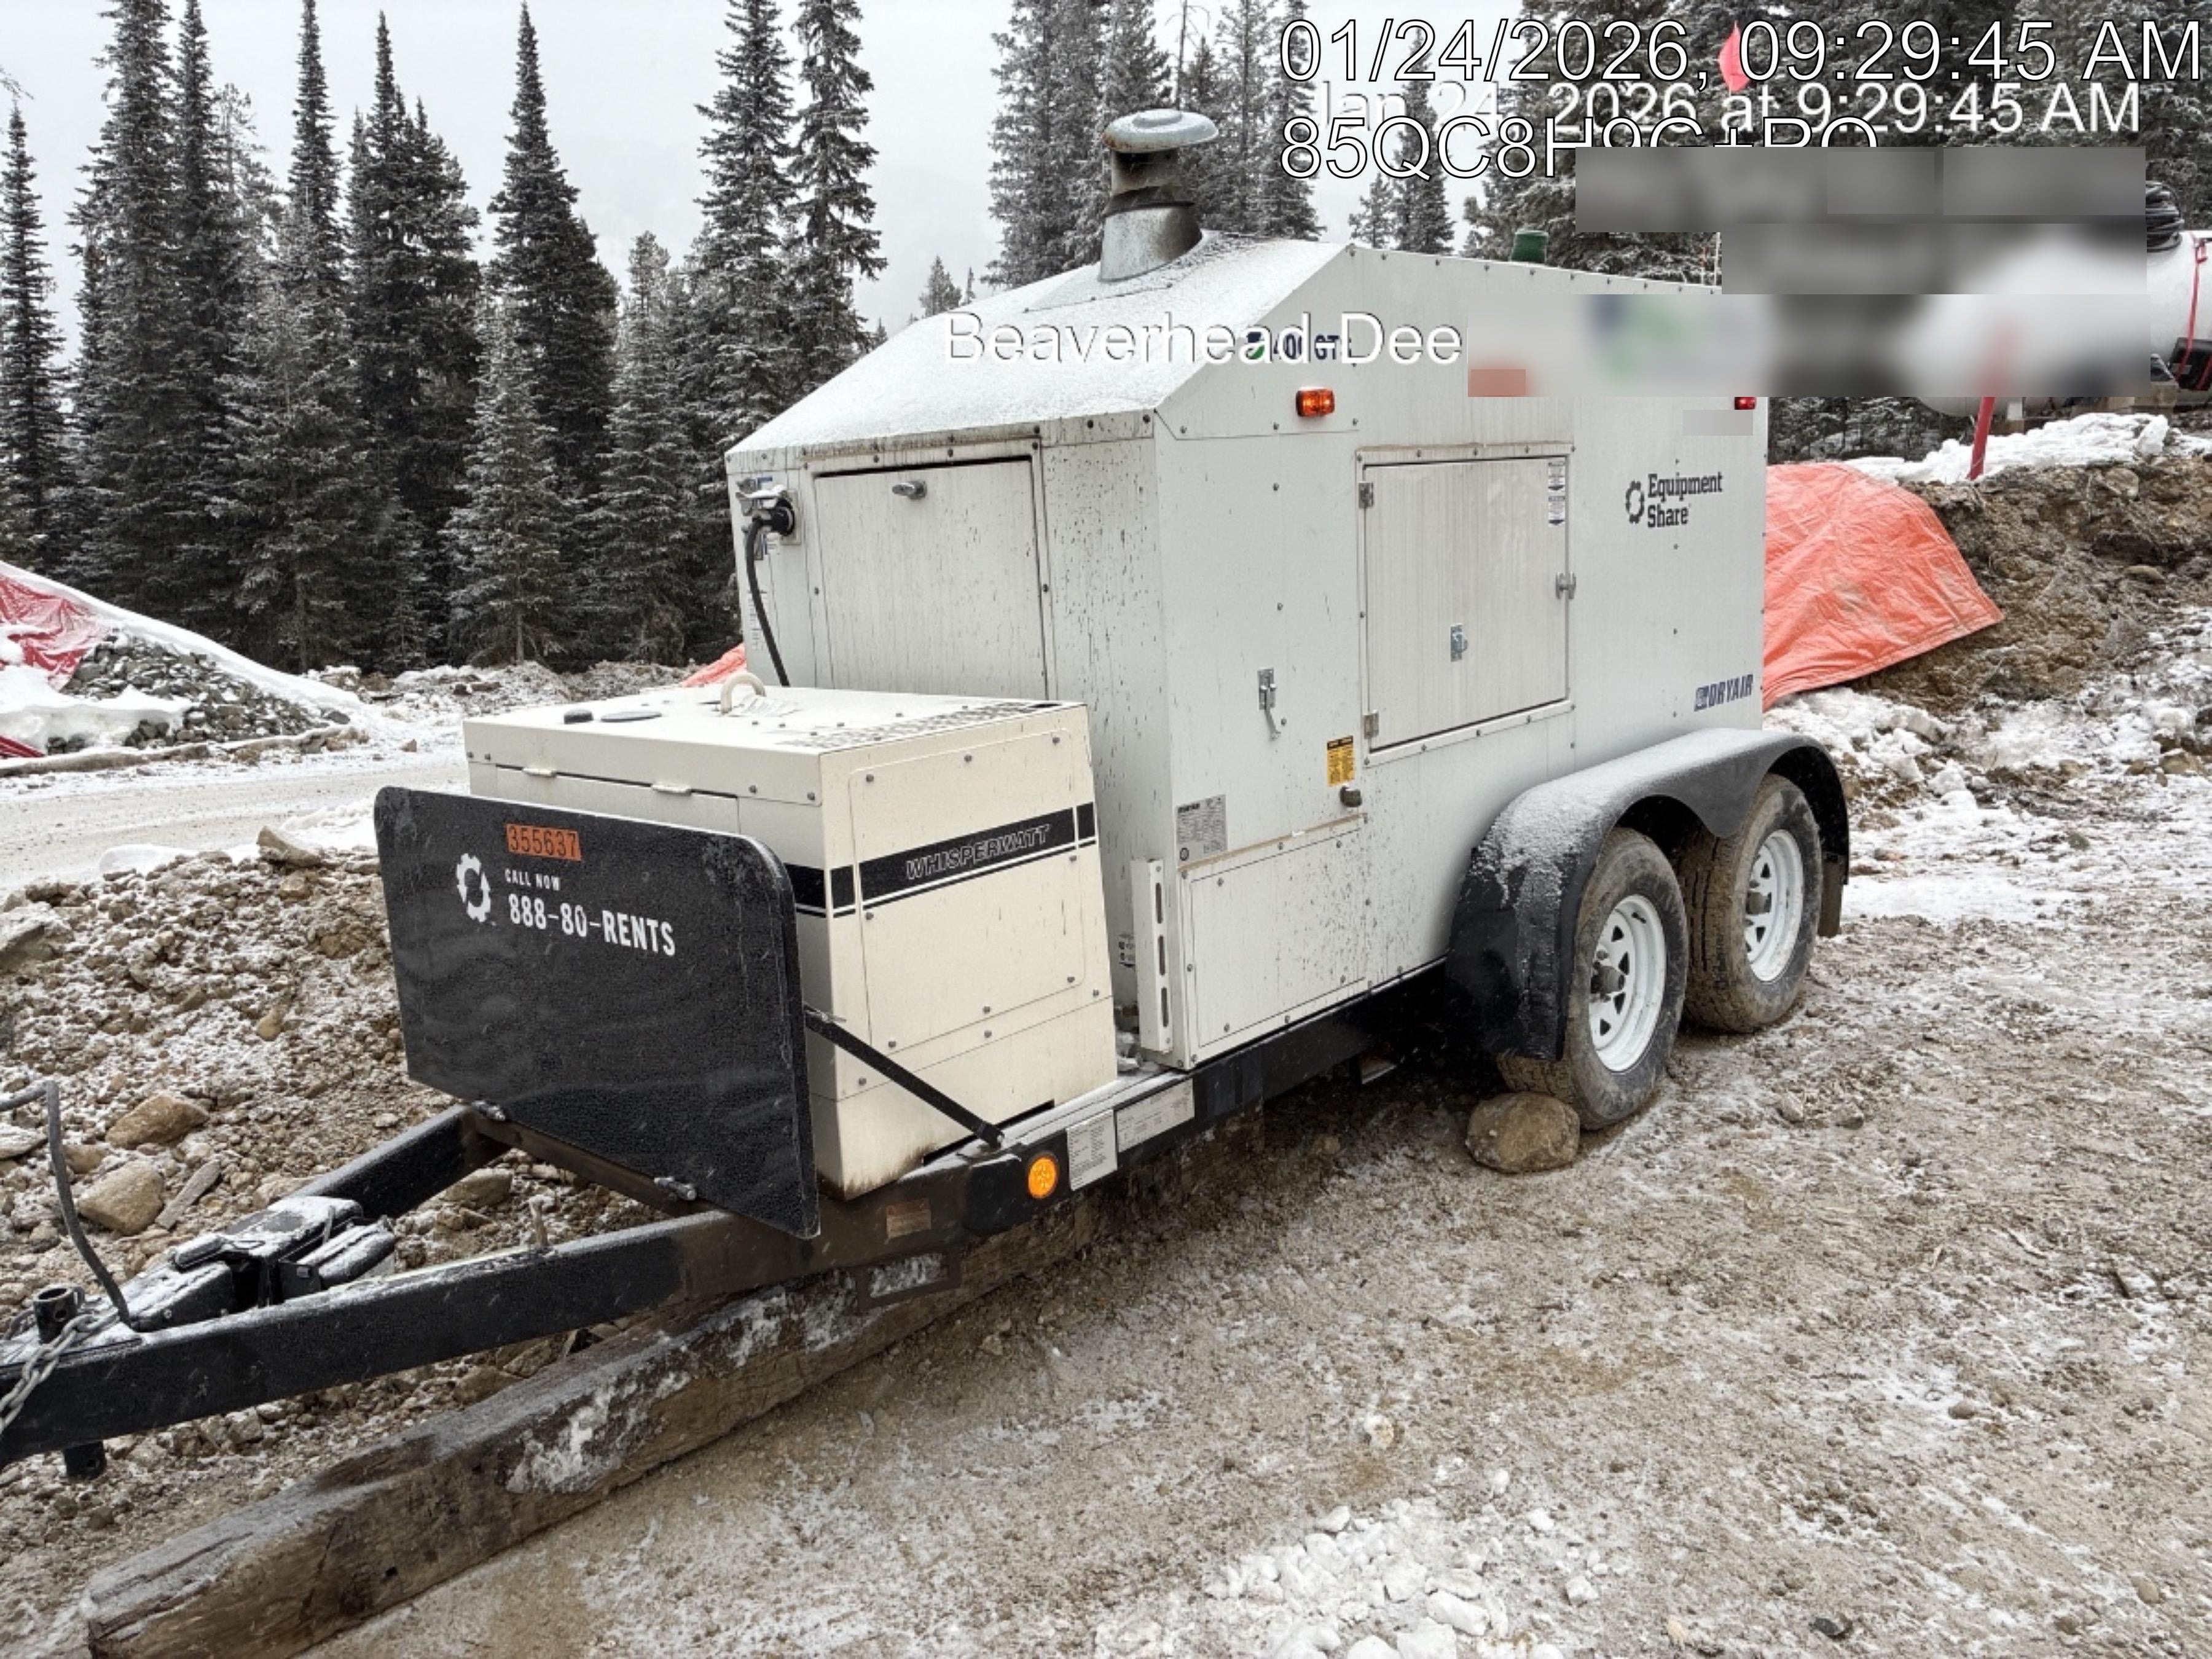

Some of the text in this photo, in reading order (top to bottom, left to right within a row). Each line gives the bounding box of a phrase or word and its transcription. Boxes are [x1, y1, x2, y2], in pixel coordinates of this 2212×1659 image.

[1647, 472, 1723, 503] Equipment
[1647, 503, 1688, 528] Share
[1708, 673, 1754, 708] DRYAIR
[509, 825, 576, 858] 355637
[906, 824, 1049, 880] WHISPERWATT
[504, 868, 560, 891] CALL NOW
[508, 893, 676, 956] 888-80-RENTS
